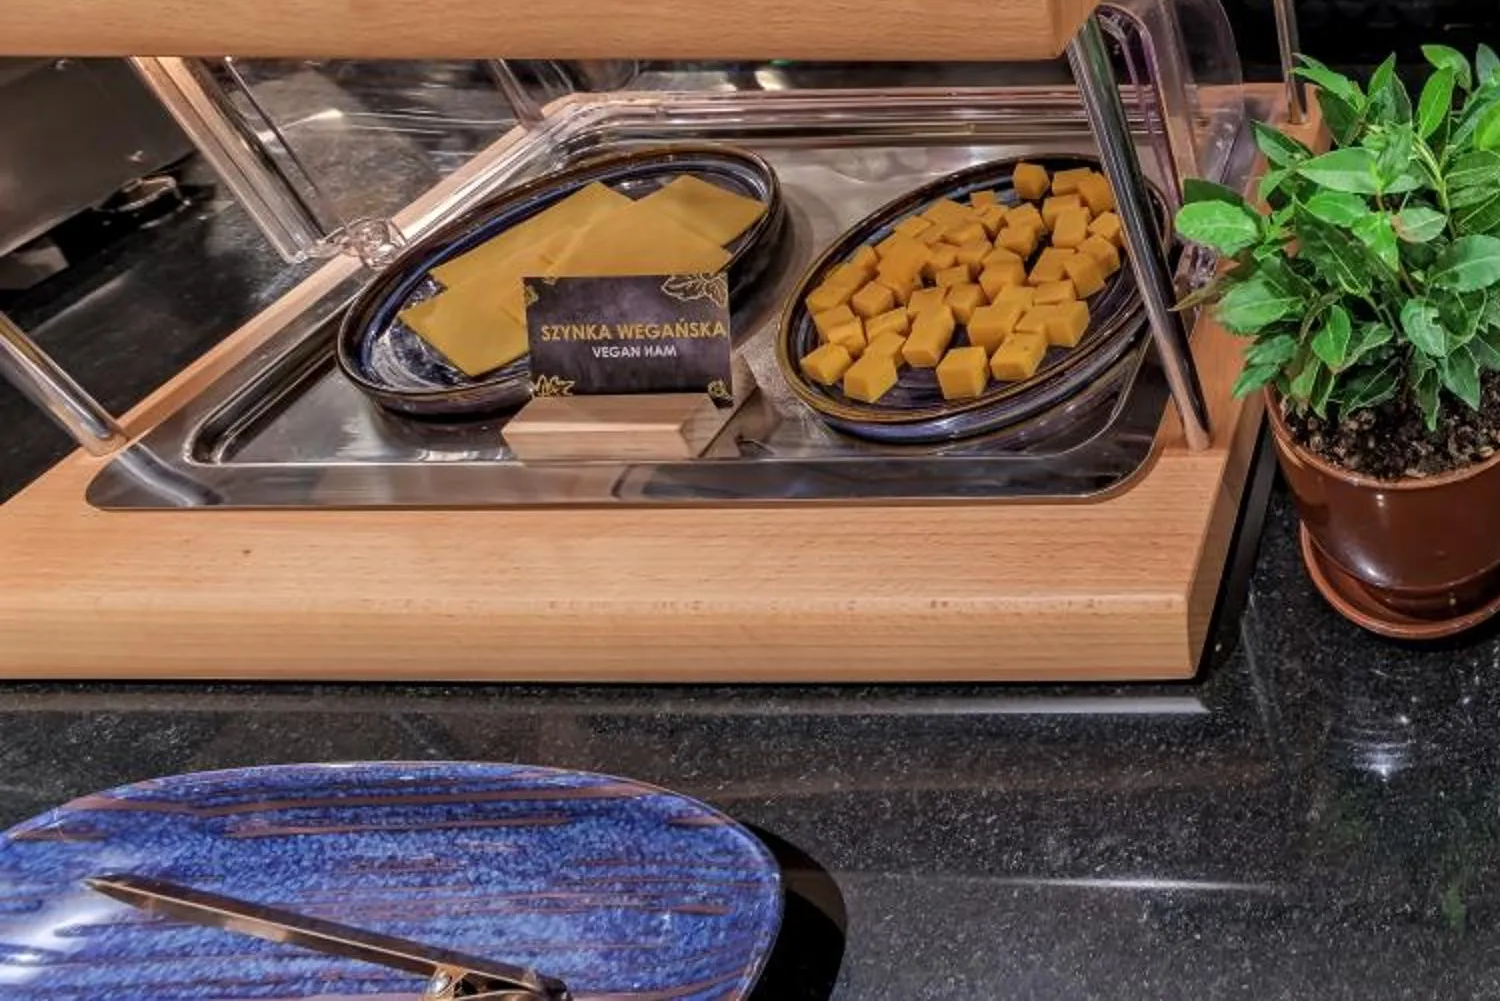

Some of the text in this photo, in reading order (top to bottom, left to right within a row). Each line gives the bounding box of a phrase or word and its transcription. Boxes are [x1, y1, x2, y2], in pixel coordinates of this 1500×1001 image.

[540, 318, 727, 341] SZYNKA WEGAŃSKA
[592, 345, 678, 359] VEGAN HAM
